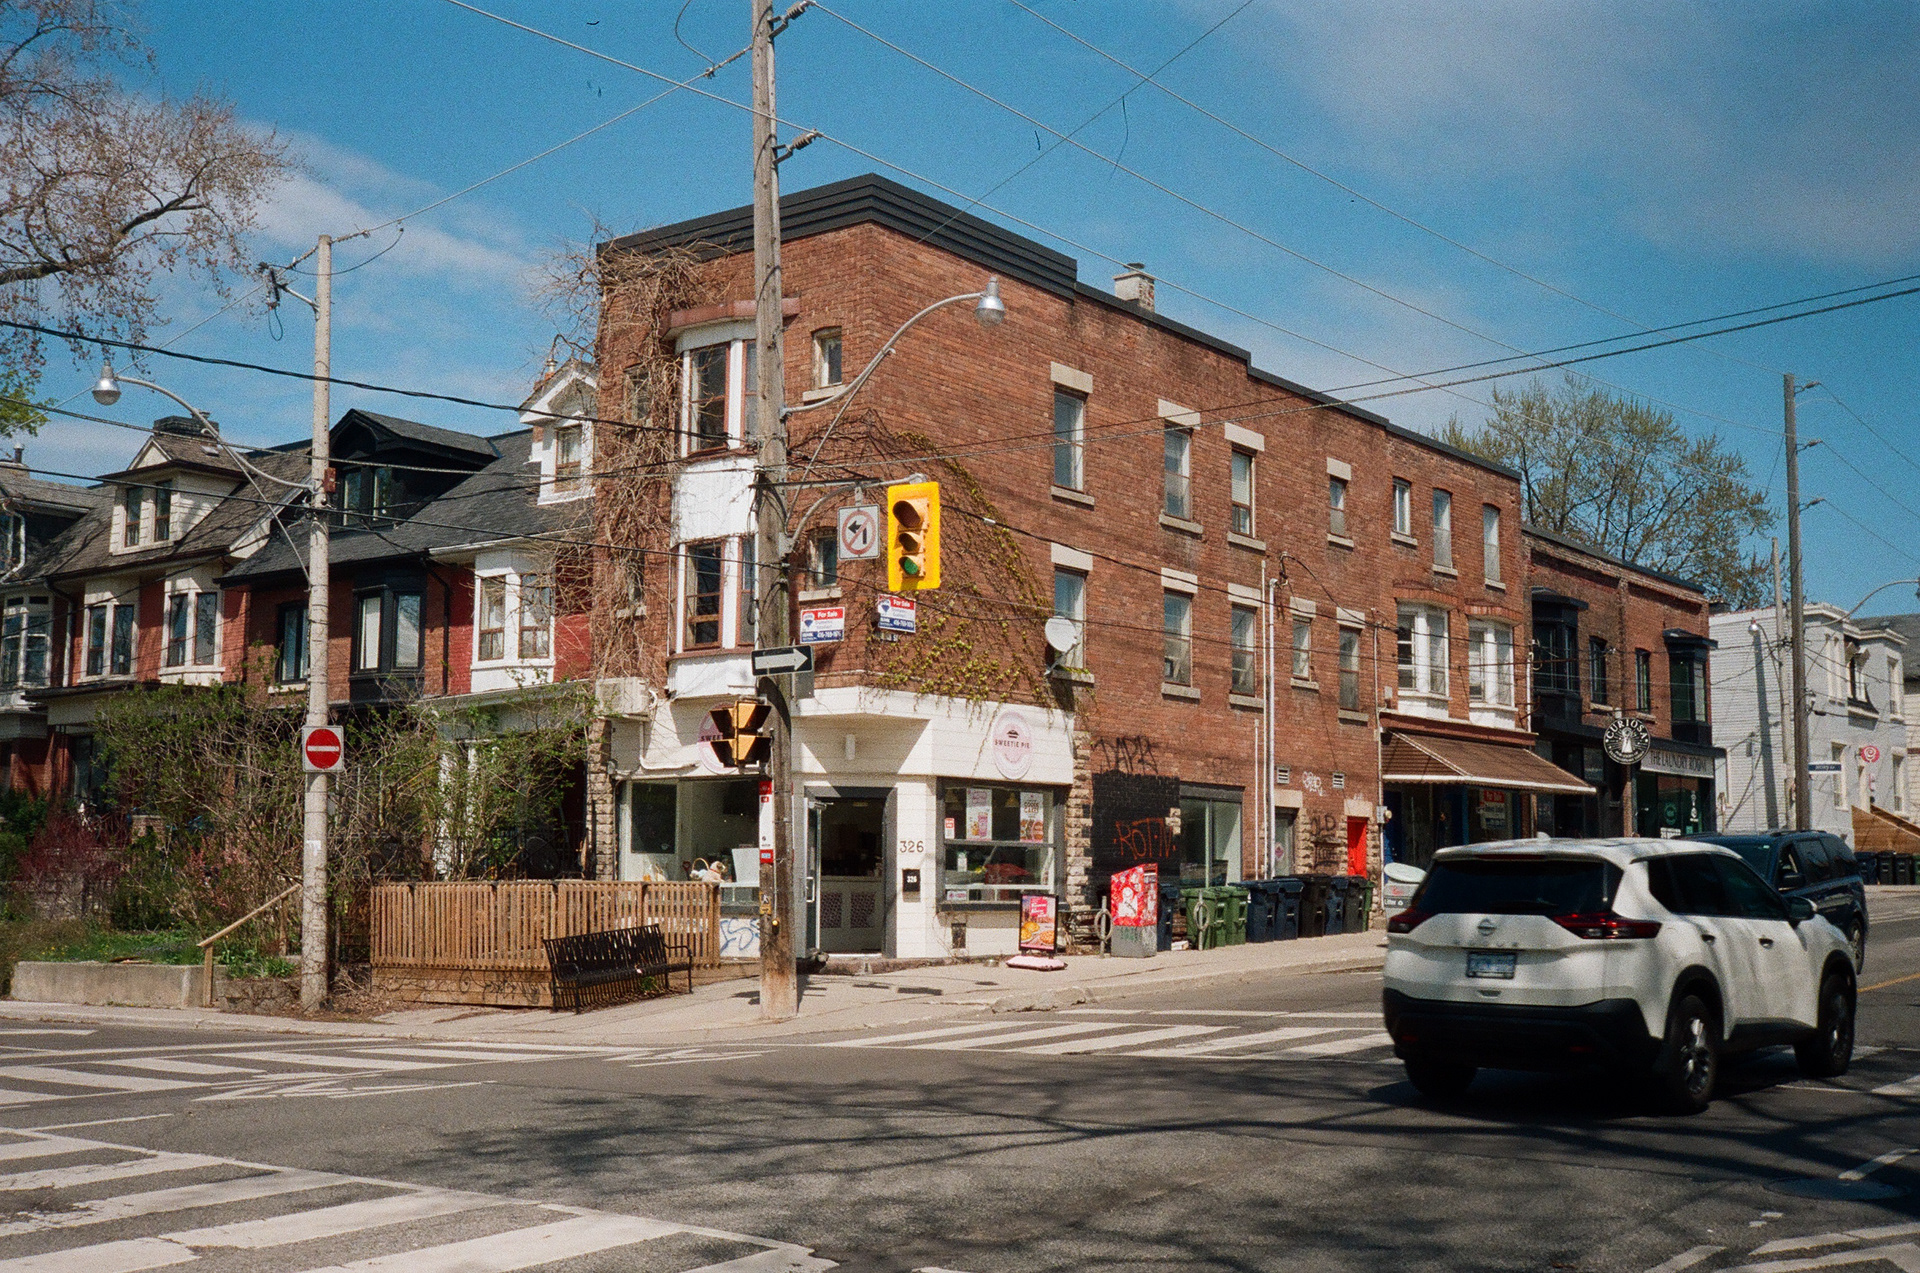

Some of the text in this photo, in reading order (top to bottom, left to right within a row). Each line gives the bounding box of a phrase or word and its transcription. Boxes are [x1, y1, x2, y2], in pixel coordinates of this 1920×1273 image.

[1605, 718, 1649, 740] CURIOSA
[994, 738, 1020, 749] SWEETIE
[899, 840, 925, 853] 326
